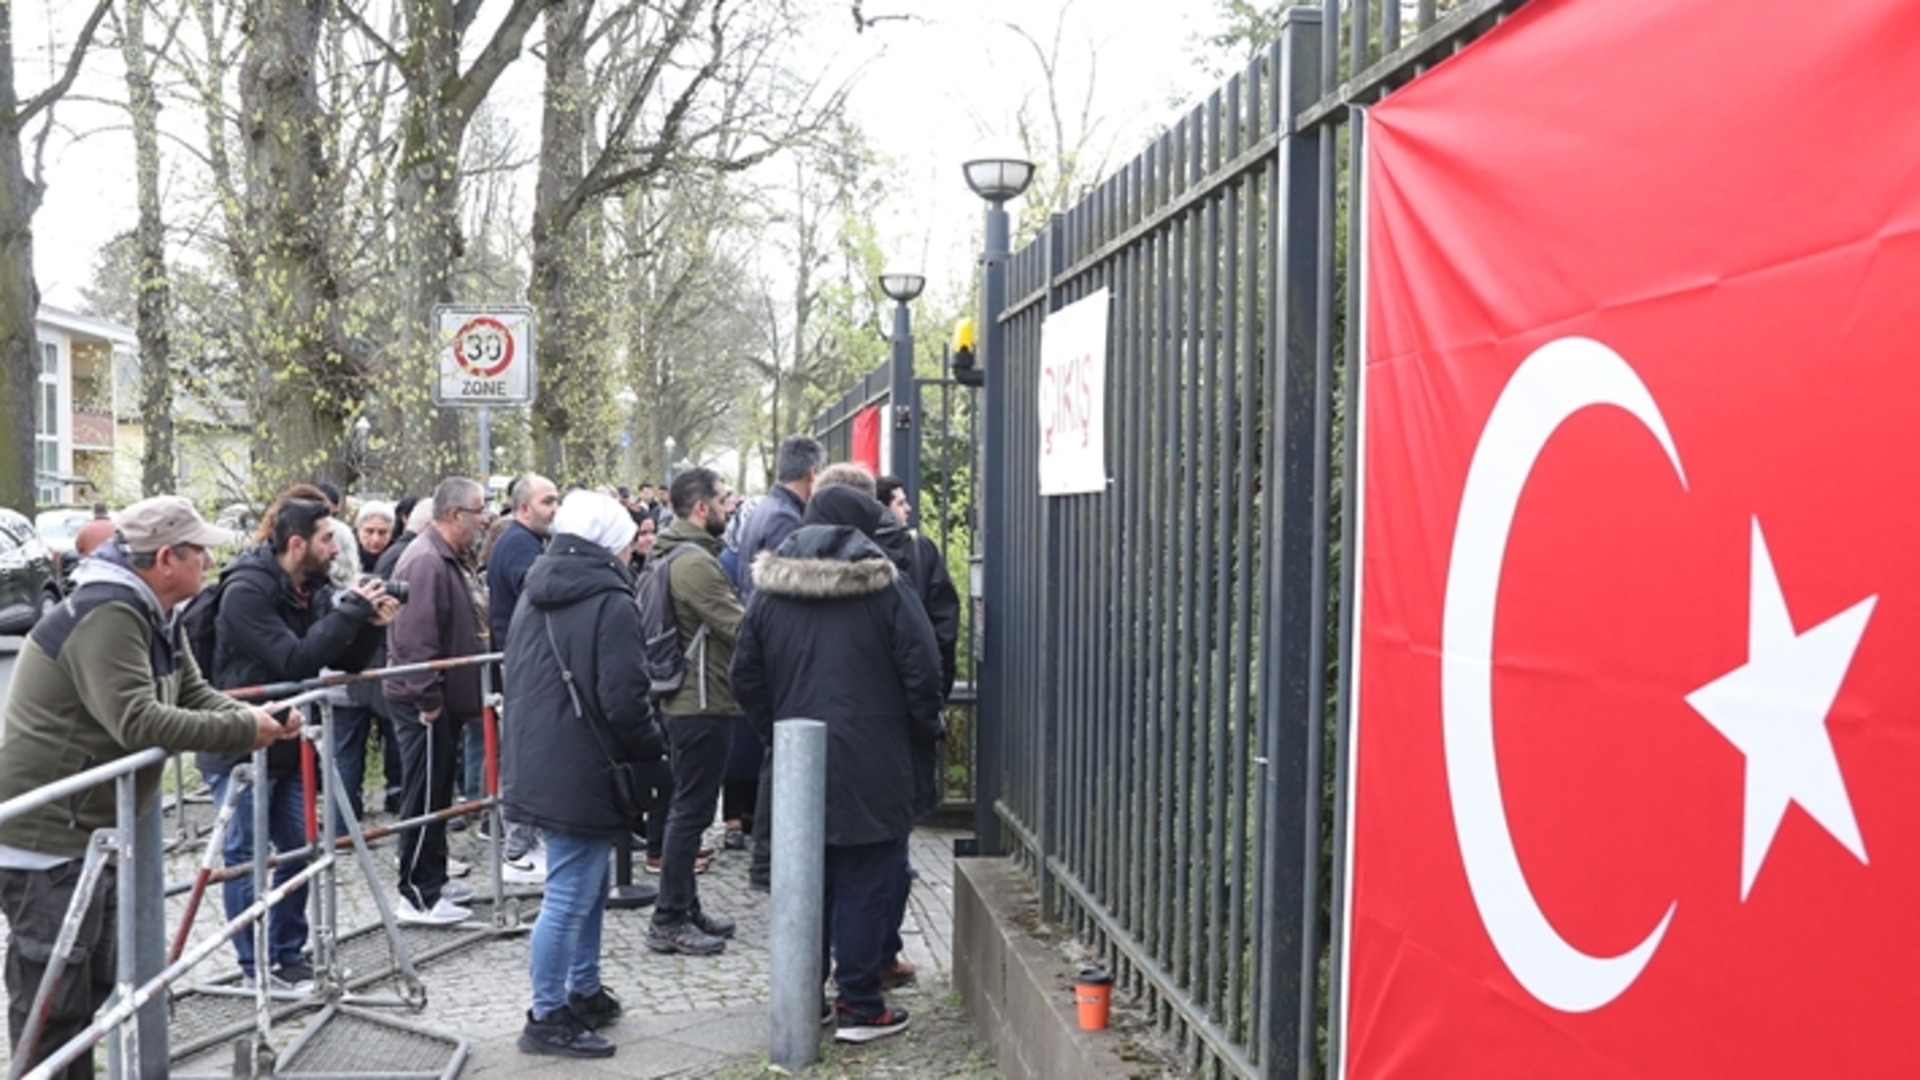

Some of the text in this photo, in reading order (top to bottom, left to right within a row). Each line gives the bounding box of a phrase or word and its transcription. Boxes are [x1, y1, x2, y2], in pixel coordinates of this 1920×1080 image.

[466, 334, 502, 361] 30
[461, 381, 507, 396] ZONE
[1043, 353, 1092, 456] ÇIKIŞ
